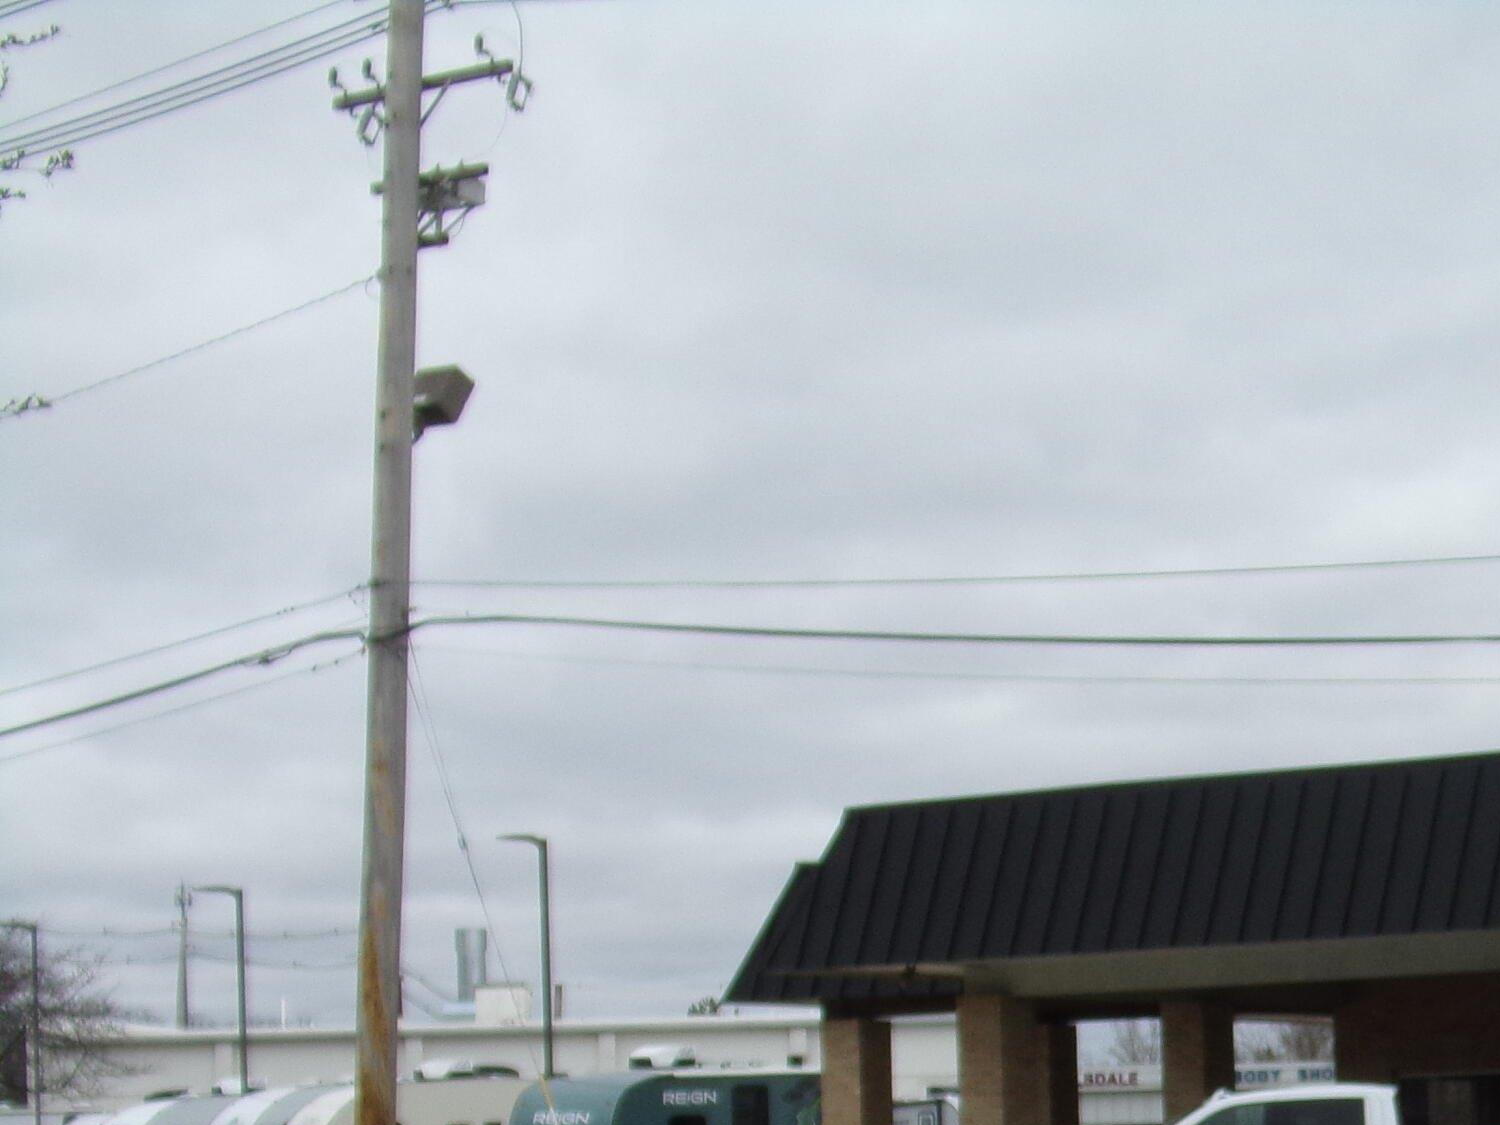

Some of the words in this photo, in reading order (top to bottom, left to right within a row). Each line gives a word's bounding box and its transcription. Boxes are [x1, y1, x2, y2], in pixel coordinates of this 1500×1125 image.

[1078, 1071, 1138, 1087] SDALE
[662, 1090, 717, 1105] REIGN
[532, 1111, 591, 1125] REIGN
